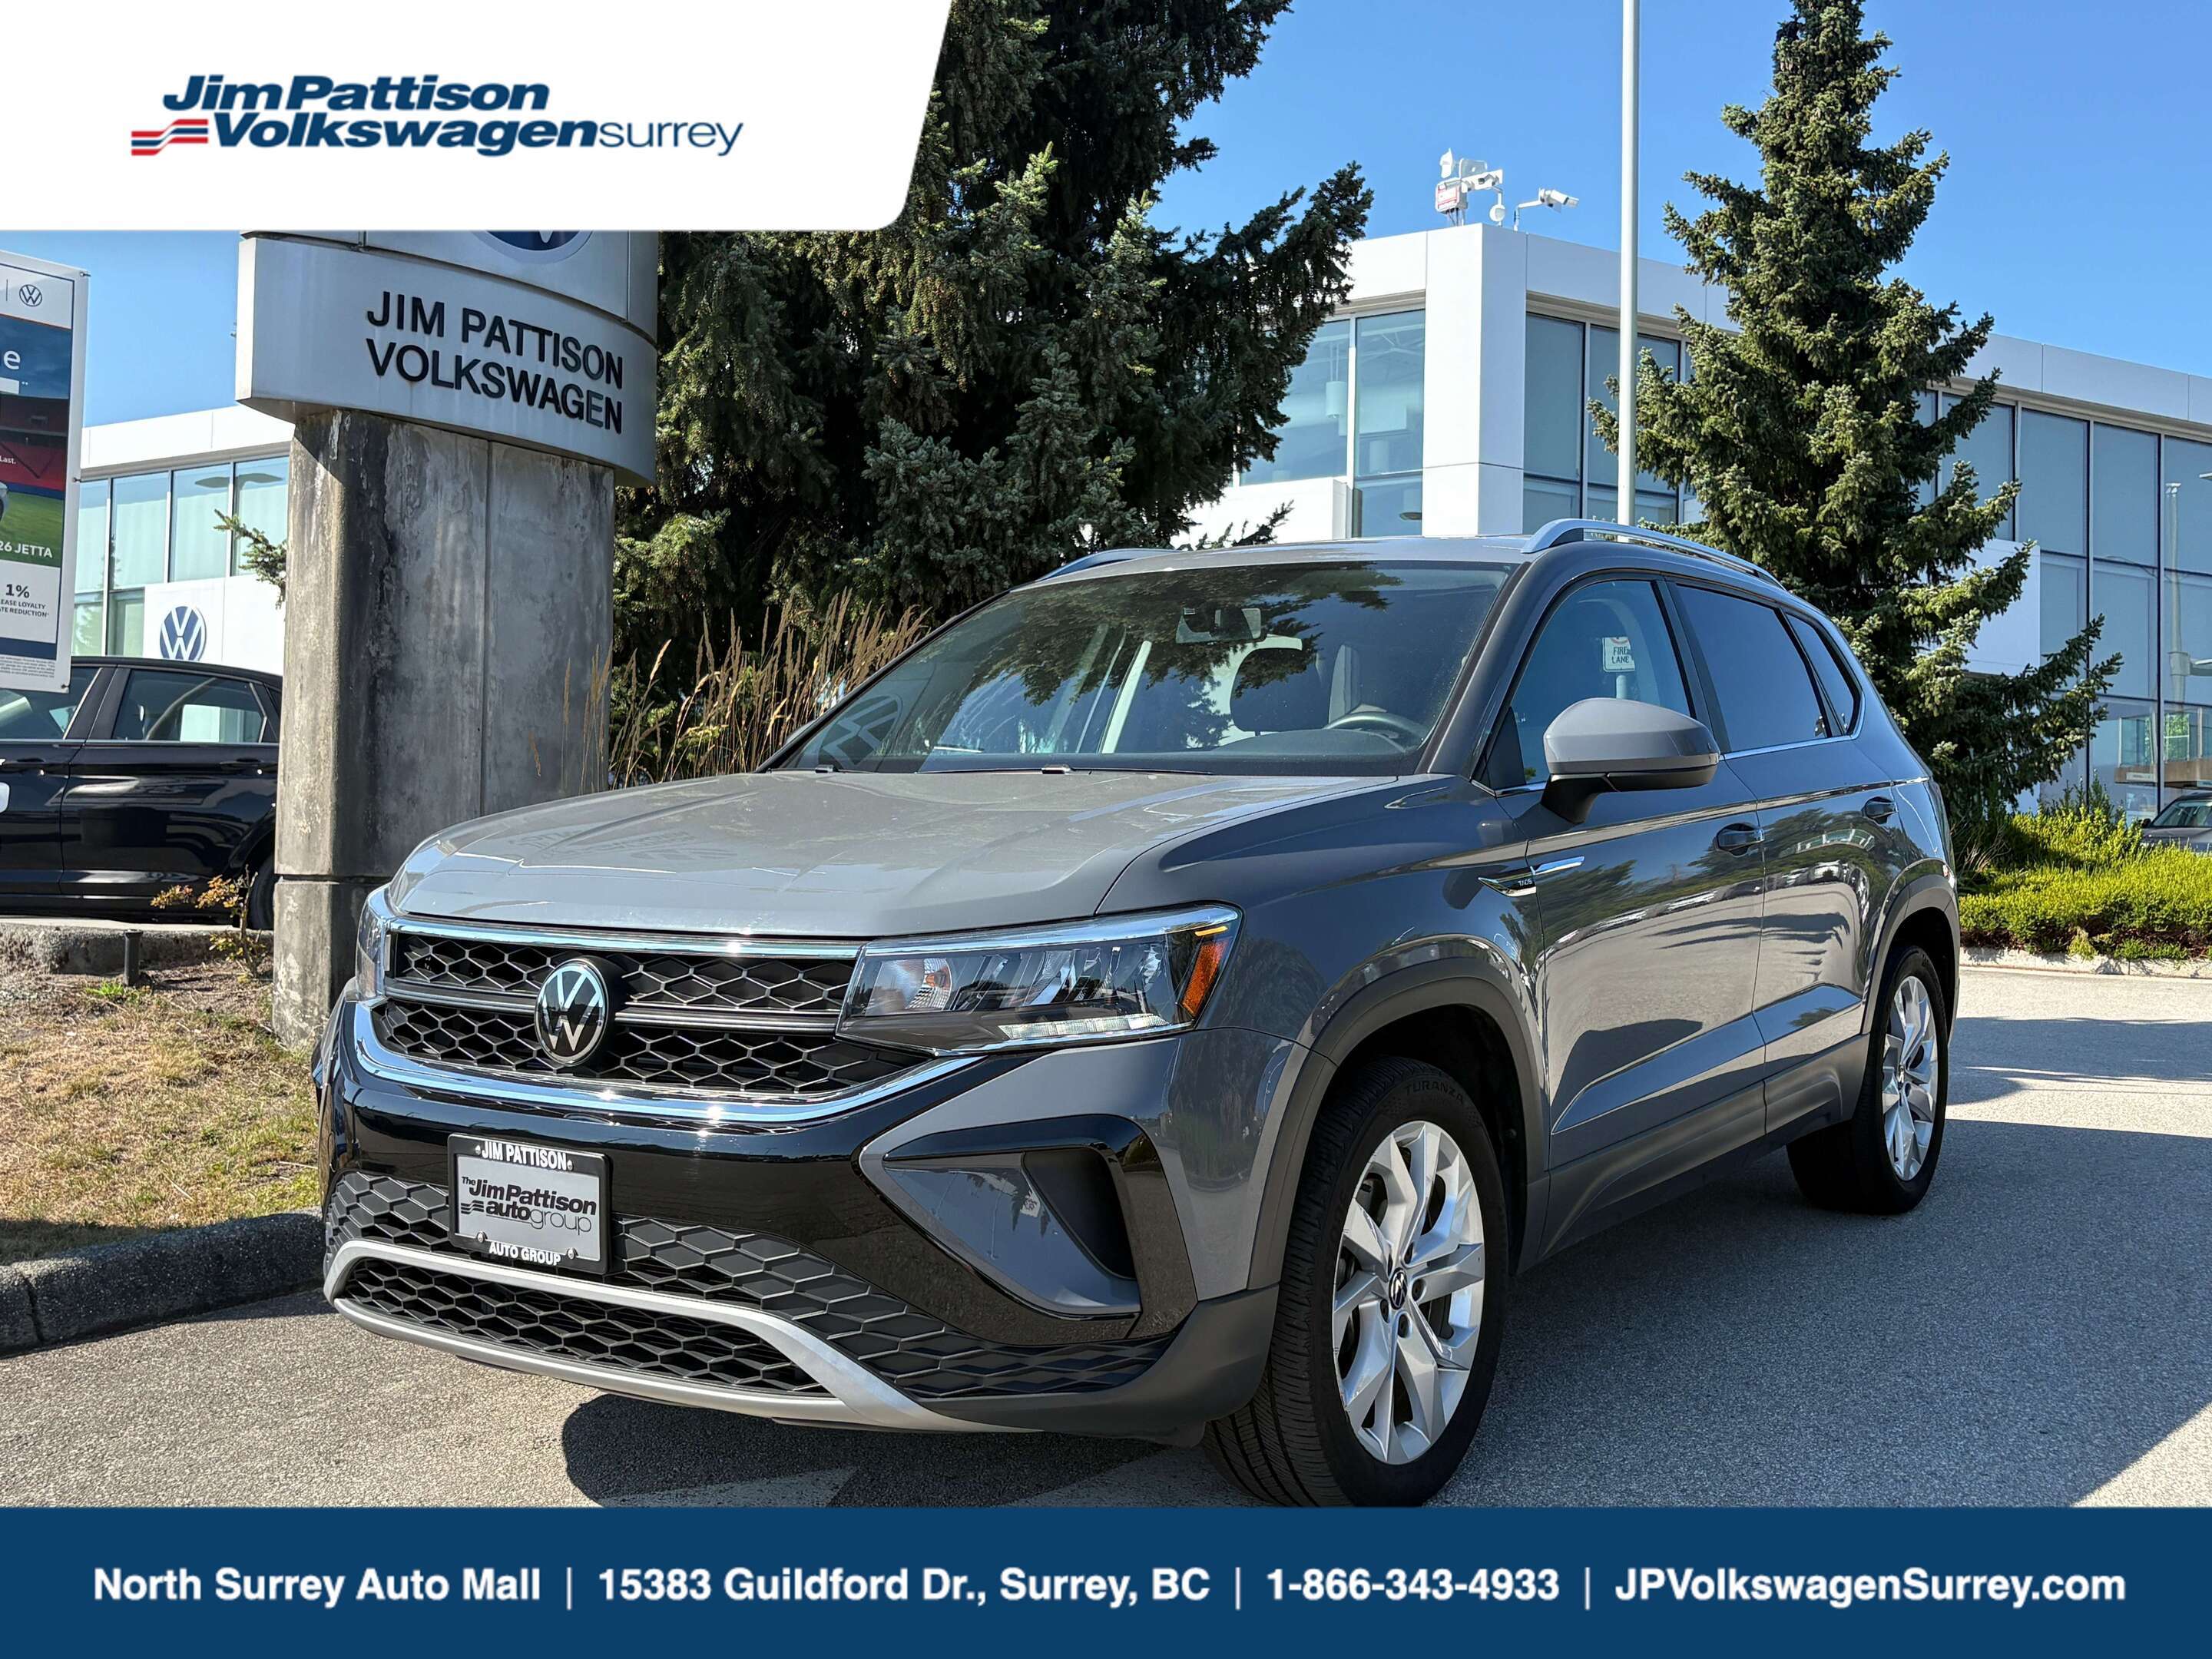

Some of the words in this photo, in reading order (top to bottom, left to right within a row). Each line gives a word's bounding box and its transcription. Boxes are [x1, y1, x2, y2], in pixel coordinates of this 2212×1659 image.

[366, 291, 445, 337] JIM
[462, 307, 623, 389] PATTISON
[366, 338, 622, 435] VOLKSWAGEN
[14, 543, 52, 558] JETTA
[5, 584, 30, 598] 1%
[482, 1141, 503, 1161] JIM
[506, 1144, 567, 1171] PATTISON
[462, 1176, 476, 1186] The
[489, 1241, 518, 1259] AUTO
[521, 1247, 561, 1266] GROUP
